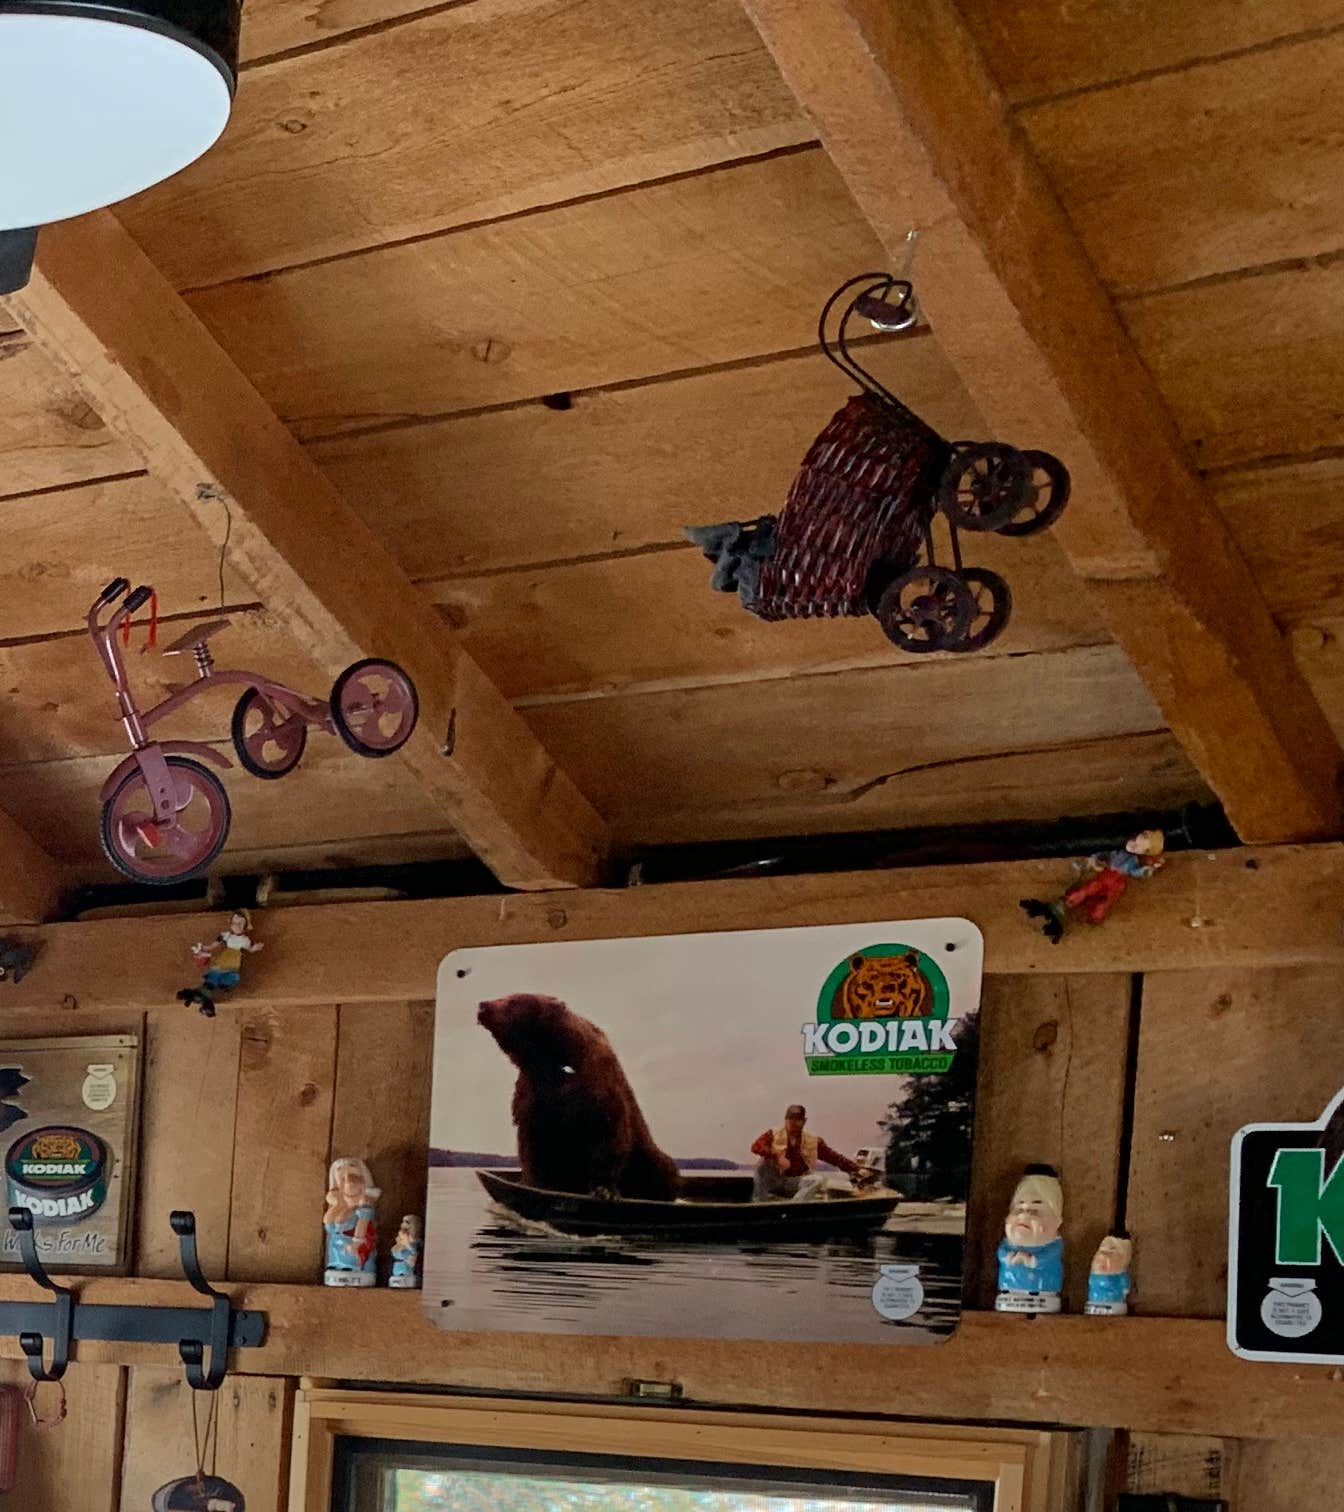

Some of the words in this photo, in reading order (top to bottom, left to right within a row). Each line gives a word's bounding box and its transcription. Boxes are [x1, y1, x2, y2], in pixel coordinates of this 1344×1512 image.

[802, 1019, 958, 1053] KODIAK
[812, 1058, 885, 1072] SMOKELESS
[889, 1056, 948, 1071] TOBACCO
[22, 1164, 87, 1175] KODIAK
[15, 1188, 95, 1217] KODIAK
[3, 1229, 52, 1252] Wks
[57, 1230, 80, 1251] For
[82, 1232, 105, 1253] Me
